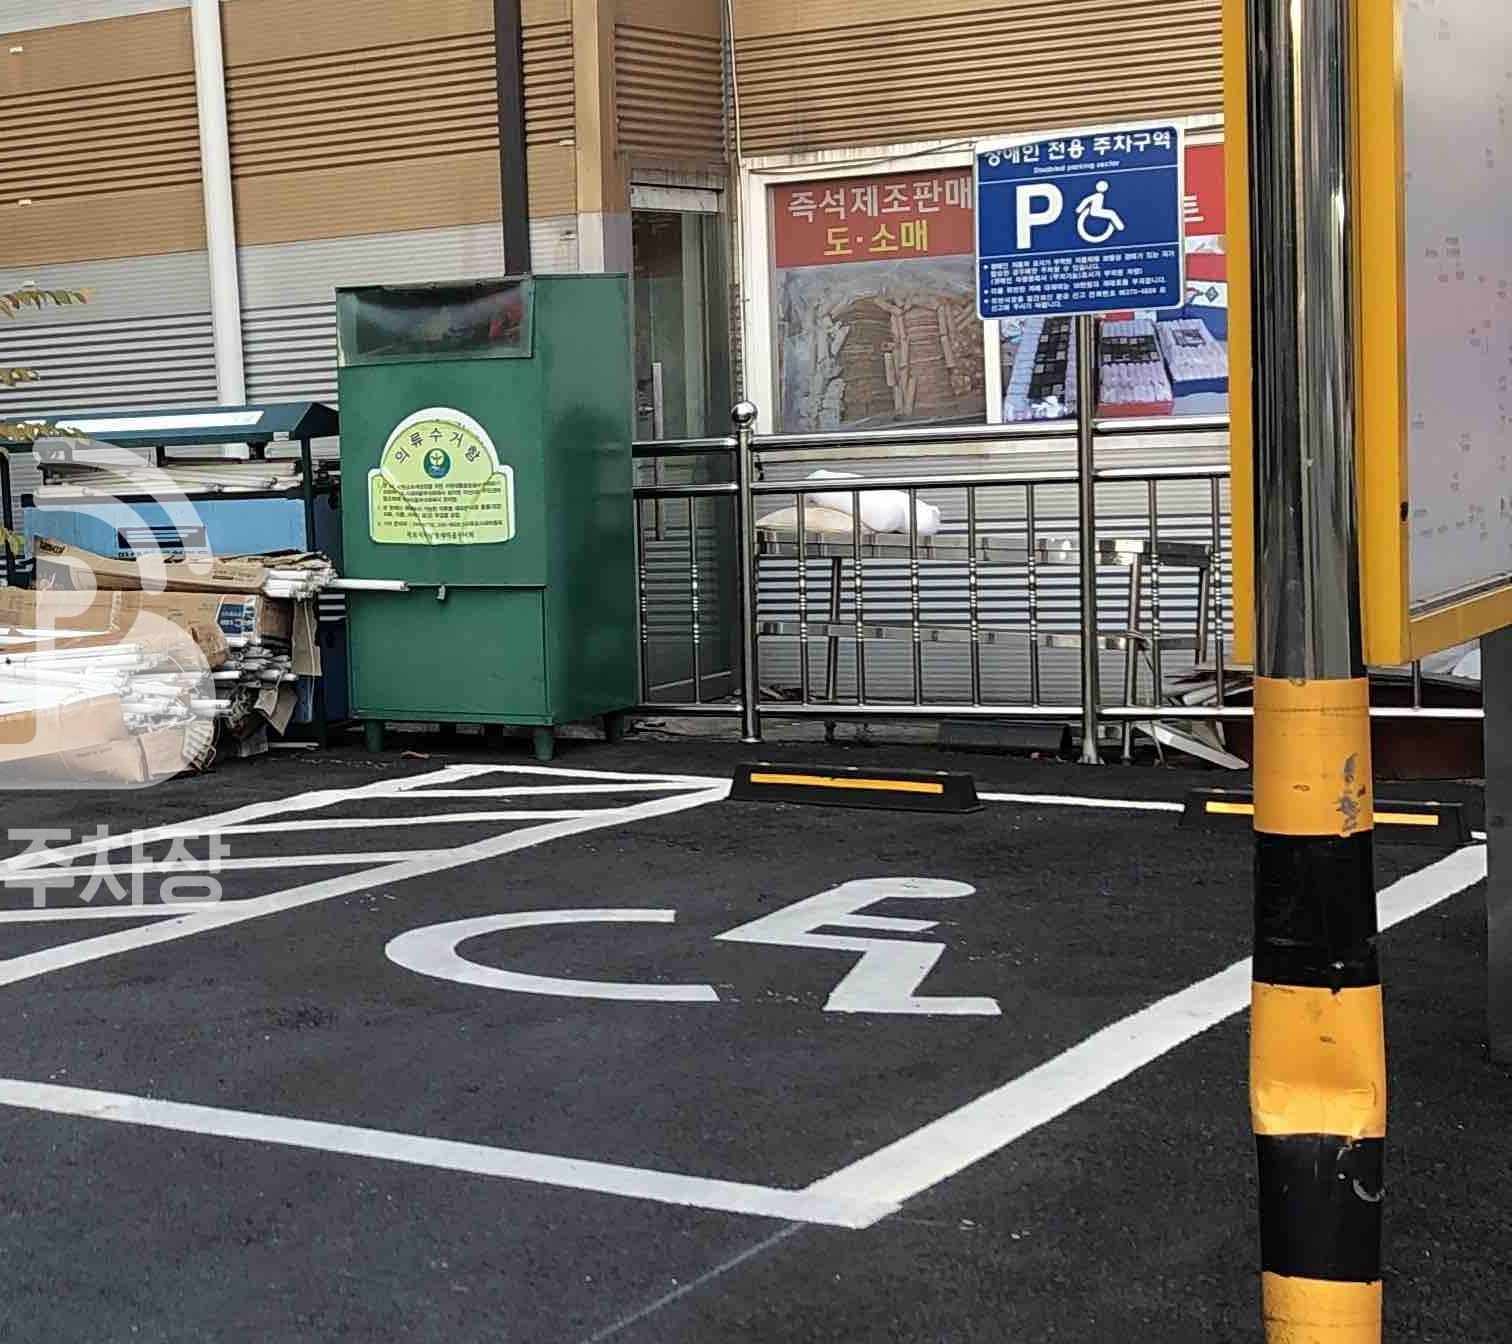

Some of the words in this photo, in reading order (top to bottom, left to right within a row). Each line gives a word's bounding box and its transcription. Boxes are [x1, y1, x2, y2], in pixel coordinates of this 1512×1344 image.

[1048, 138, 1085, 161] 전용
[1093, 130, 1171, 156] 주차구역
[788, 176, 973, 223] 즉석제조판매
[1016, 182, 1064, 249] P
[395, 427, 481, 463] 의류수거함
